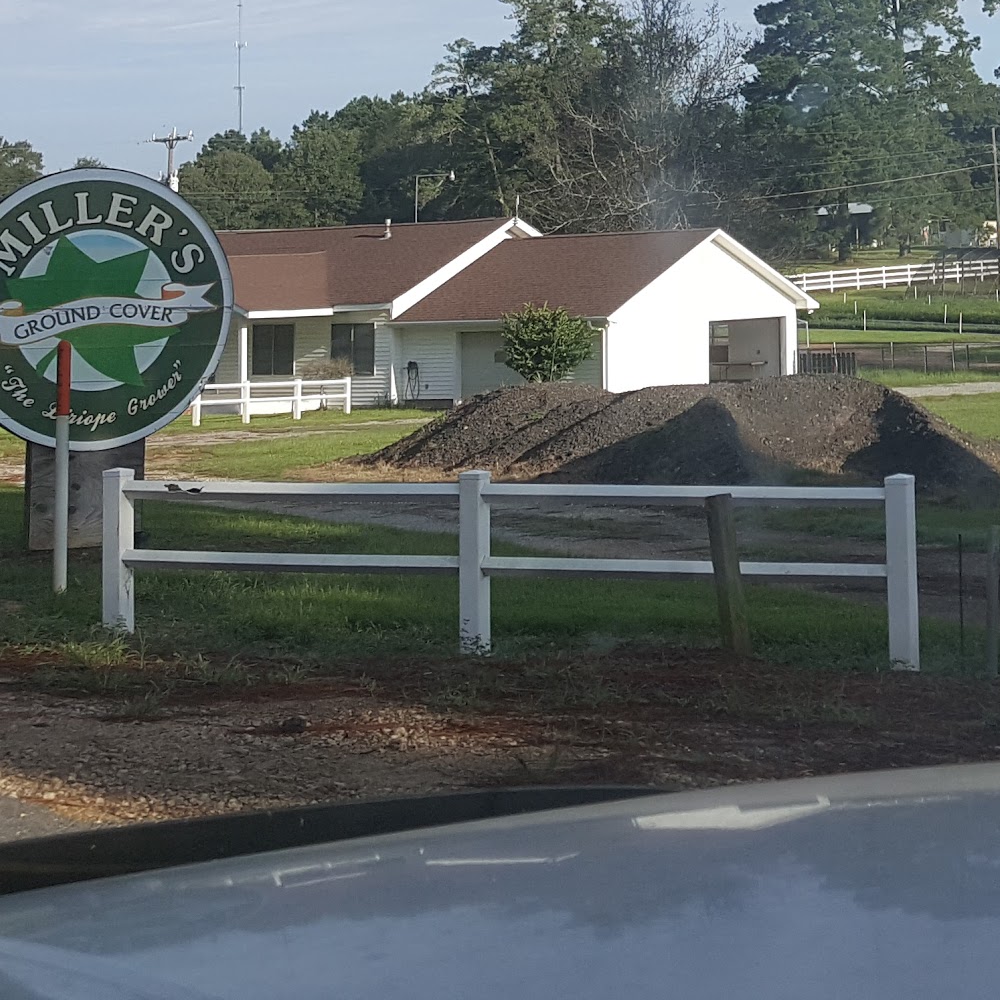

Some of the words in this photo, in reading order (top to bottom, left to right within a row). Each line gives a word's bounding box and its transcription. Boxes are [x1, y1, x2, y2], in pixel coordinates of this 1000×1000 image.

[0, 192, 205, 276] MILLER'S
[14, 307, 100, 339] GROUND
[110, 303, 173, 323] COVER
[1, 364, 35, 408] "The
[41, 402, 117, 432] Lriope
[127, 359, 182, 416] Grower"
